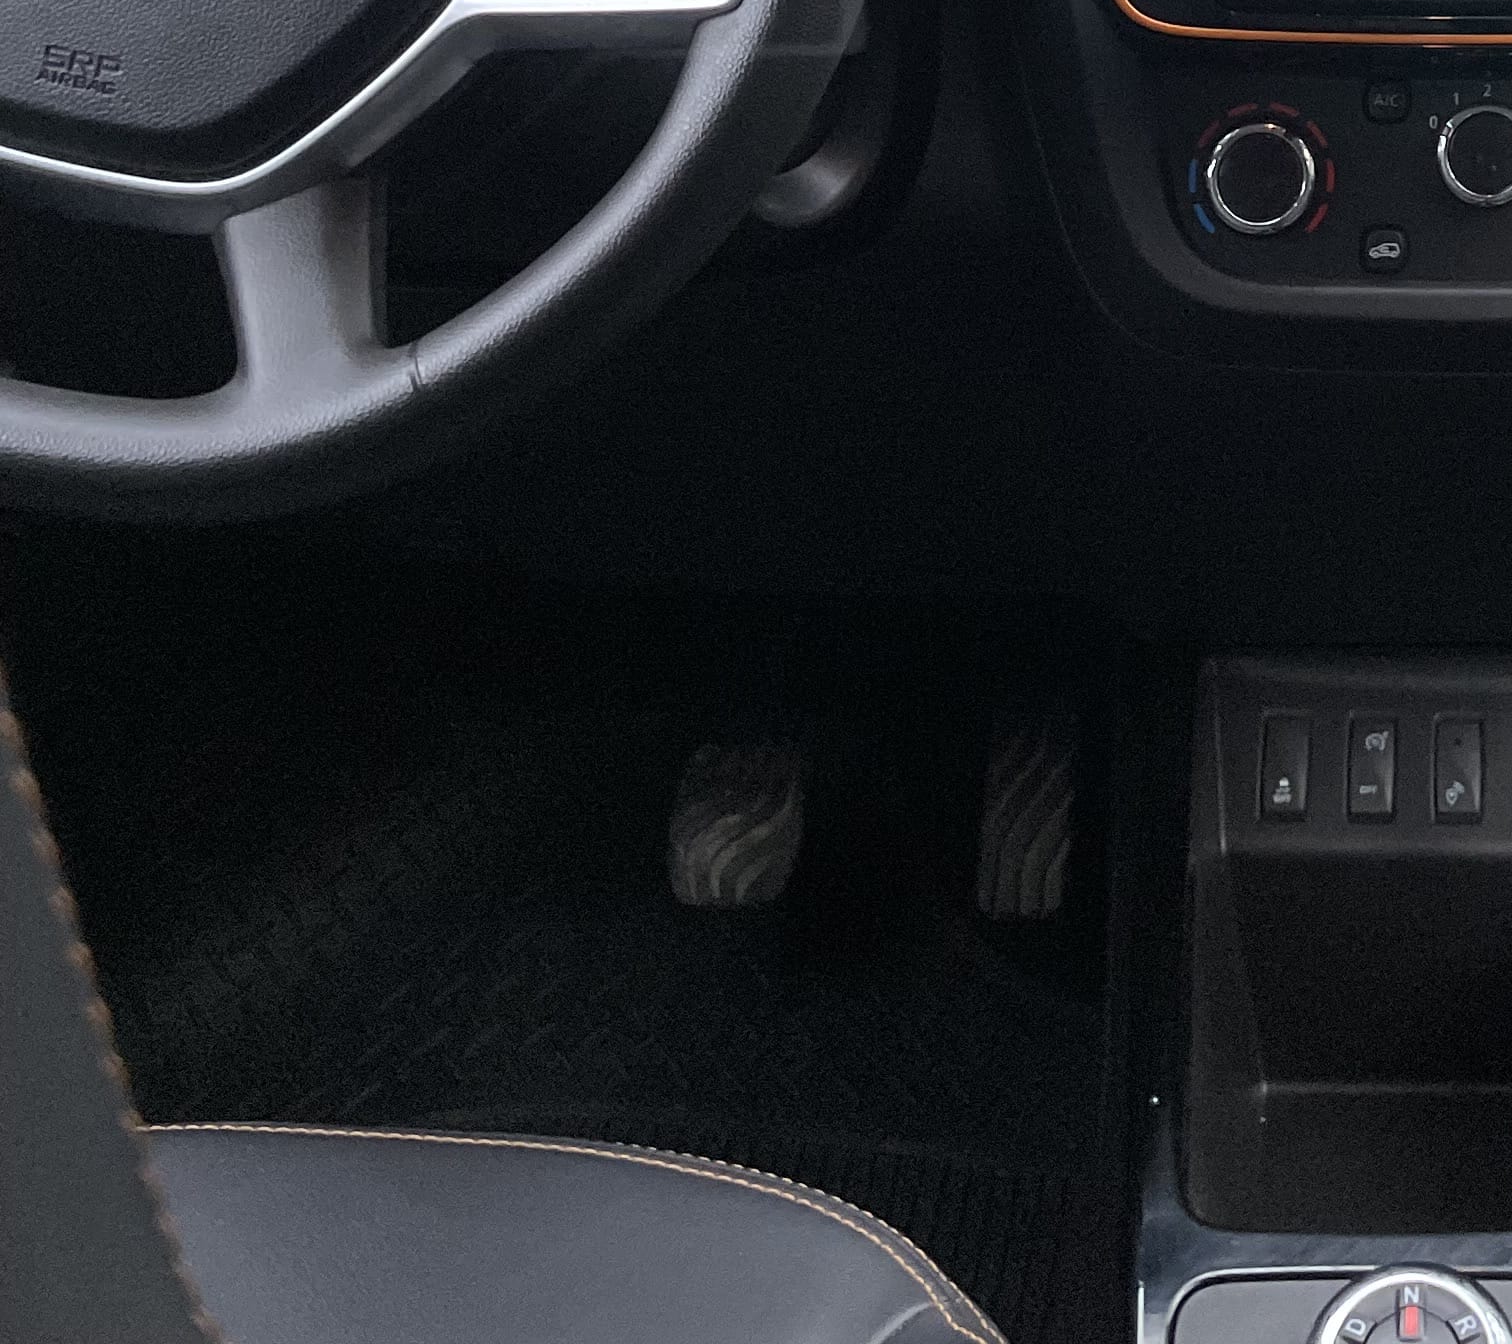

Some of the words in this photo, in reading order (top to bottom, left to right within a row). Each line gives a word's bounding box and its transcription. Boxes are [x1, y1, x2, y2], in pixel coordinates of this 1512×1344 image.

[42, 45, 121, 78] SRP
[35, 69, 117, 94] AIRBAG
[1429, 115, 1438, 129] 0
[1453, 93, 1460, 106] 1
[1483, 83, 1492, 97] 2
[1345, 1318, 1367, 1336] D
[1403, 1286, 1420, 1304] N
[1454, 1315, 1477, 1335] R
